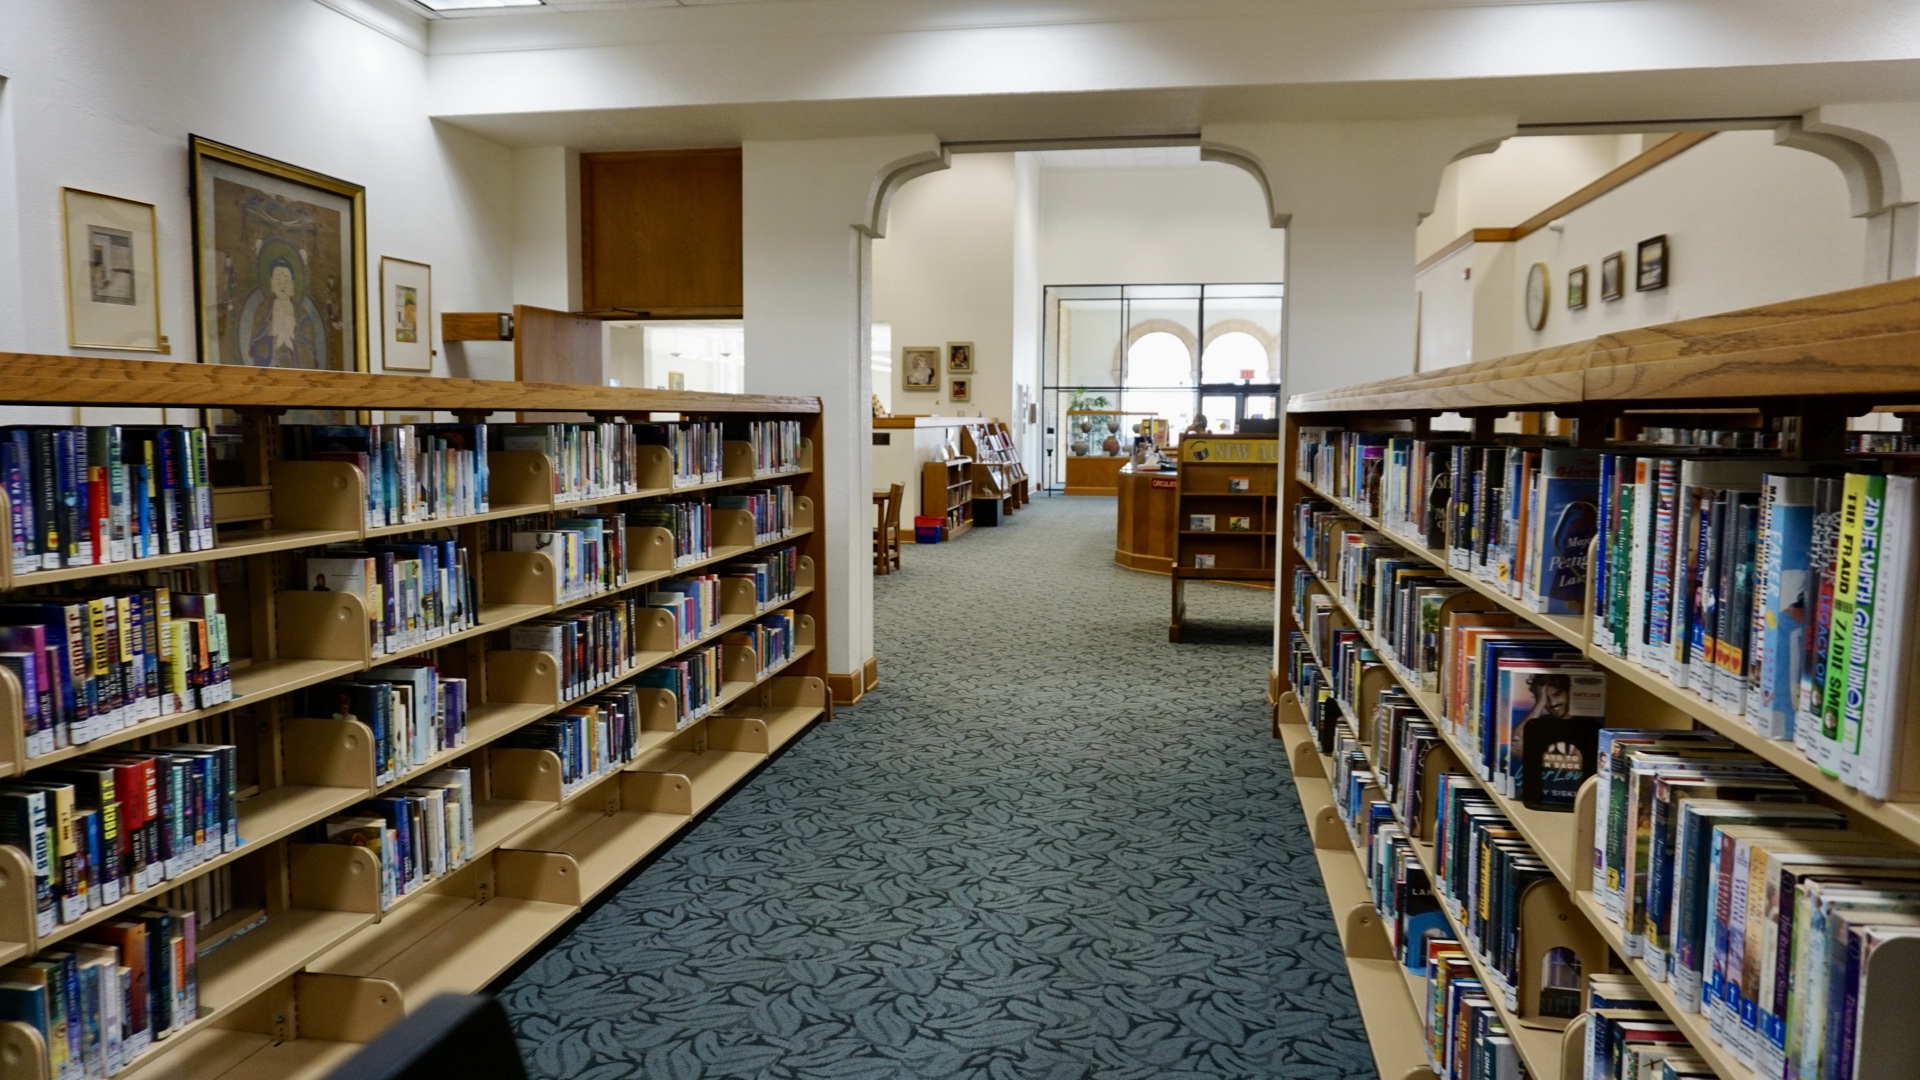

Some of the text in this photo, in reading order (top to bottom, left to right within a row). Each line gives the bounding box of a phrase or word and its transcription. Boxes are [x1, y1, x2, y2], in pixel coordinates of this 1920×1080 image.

[76, 432, 88, 483] KAREN ROBARDS
[1215, 443, 1251, 460] NEW
[41, 433, 54, 511] KAREN ROBARDS
[111, 460, 122, 493] ROBB
[166, 460, 175, 485] ROBB
[199, 458, 208, 483] ROBB
[1846, 493, 1858, 528] THE
[1618, 516, 1629, 555] Capture
[1549, 552, 1590, 572] Pettig
[1767, 530, 1783, 598] FAKER
[1839, 534, 1854, 595] FRAUD
[1559, 573, 1587, 587] Las
[1617, 570, 1626, 600] Castle
[1845, 496, 1880, 720] ZADIE SMITH GRAND UNION
[1876, 572, 1889, 628] SMITH
[160, 622, 172, 656] ROBB
[1718, 608, 1726, 637] LAURE
[71, 640, 84, 677] ROBB
[94, 633, 107, 670] ROBB
[106, 629, 119, 664] ROBB
[1815, 594, 1832, 688] LEGACY OF
[1832, 619, 1847, 673] ZADIE
[1828, 676, 1842, 709] SM
[1866, 668, 1879, 738] BEAUTY
[1553, 769, 1583, 782] Lov
[1554, 762, 1581, 770] BACK
[147, 789, 158, 816] ROBB
[104, 804, 117, 840] ROBB
[36, 832, 48, 869] ROBB
[1776, 979, 1786, 1008] SONG
[1460, 1020, 1468, 1050] EARLY
